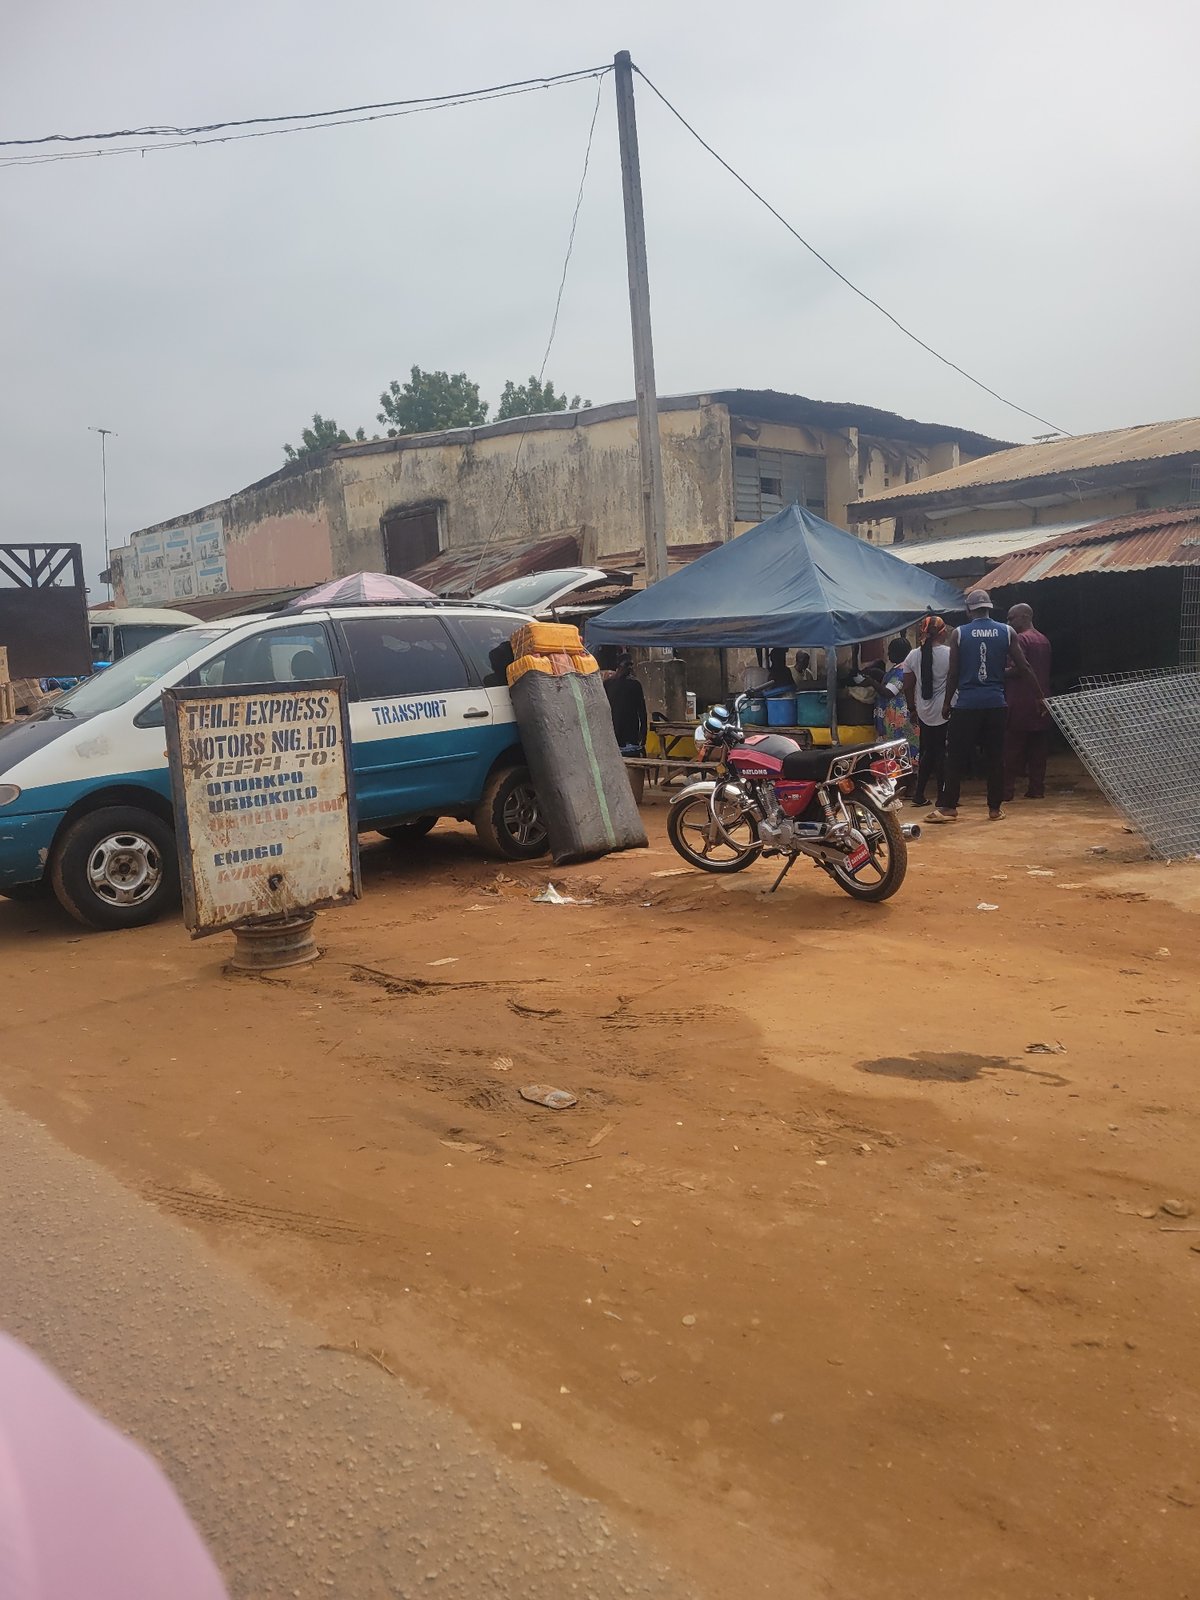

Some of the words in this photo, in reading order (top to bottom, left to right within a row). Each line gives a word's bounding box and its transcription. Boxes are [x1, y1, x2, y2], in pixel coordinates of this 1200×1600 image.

[245, 696, 329, 726] EXPRESS
[371, 699, 447, 725] TRANSPORT
[188, 731, 266, 762] MOTORS
[193, 756, 282, 779] KEFFI
[208, 786, 318, 814] UGBOKOLO
[213, 843, 283, 867] ENUGU
